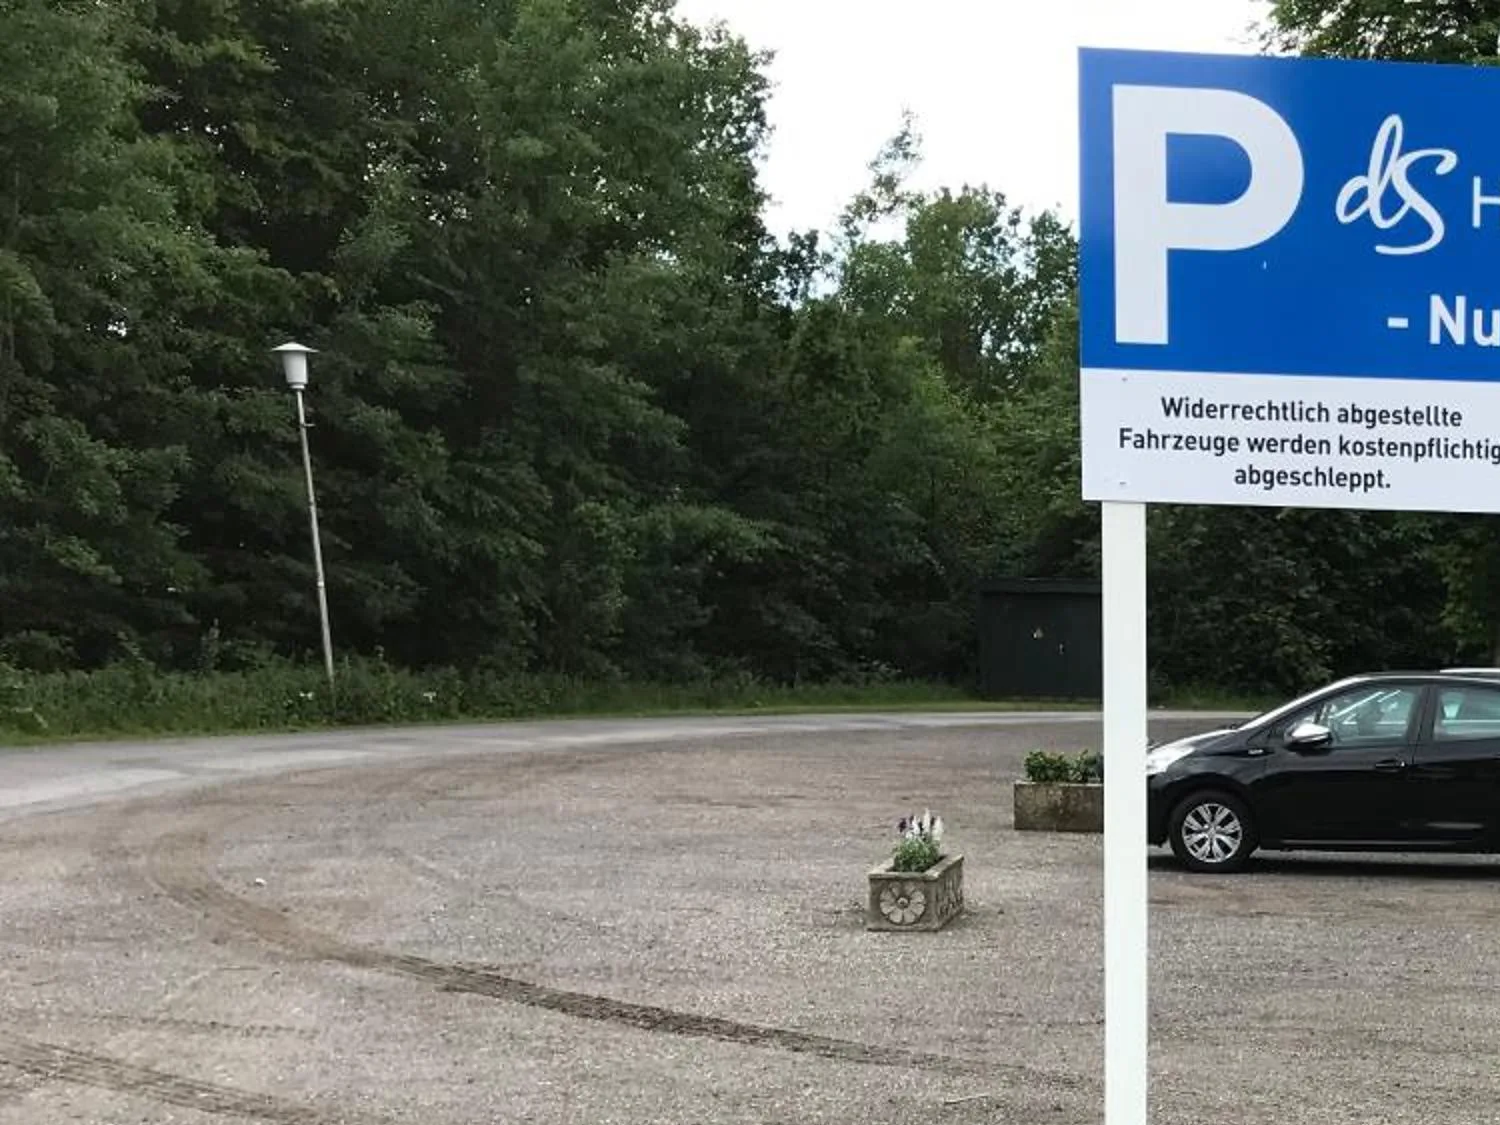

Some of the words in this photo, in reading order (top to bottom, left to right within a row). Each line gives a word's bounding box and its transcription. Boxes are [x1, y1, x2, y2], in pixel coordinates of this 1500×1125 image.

[1111, 84, 1304, 345] P
[1161, 396, 1330, 423] Widerrechtlich
[1337, 403, 1463, 430] abgestellte
[1119, 427, 1240, 457] Fahrzeuge
[1246, 433, 1331, 455] werden
[1235, 464, 1391, 493] abgeschleppt.
